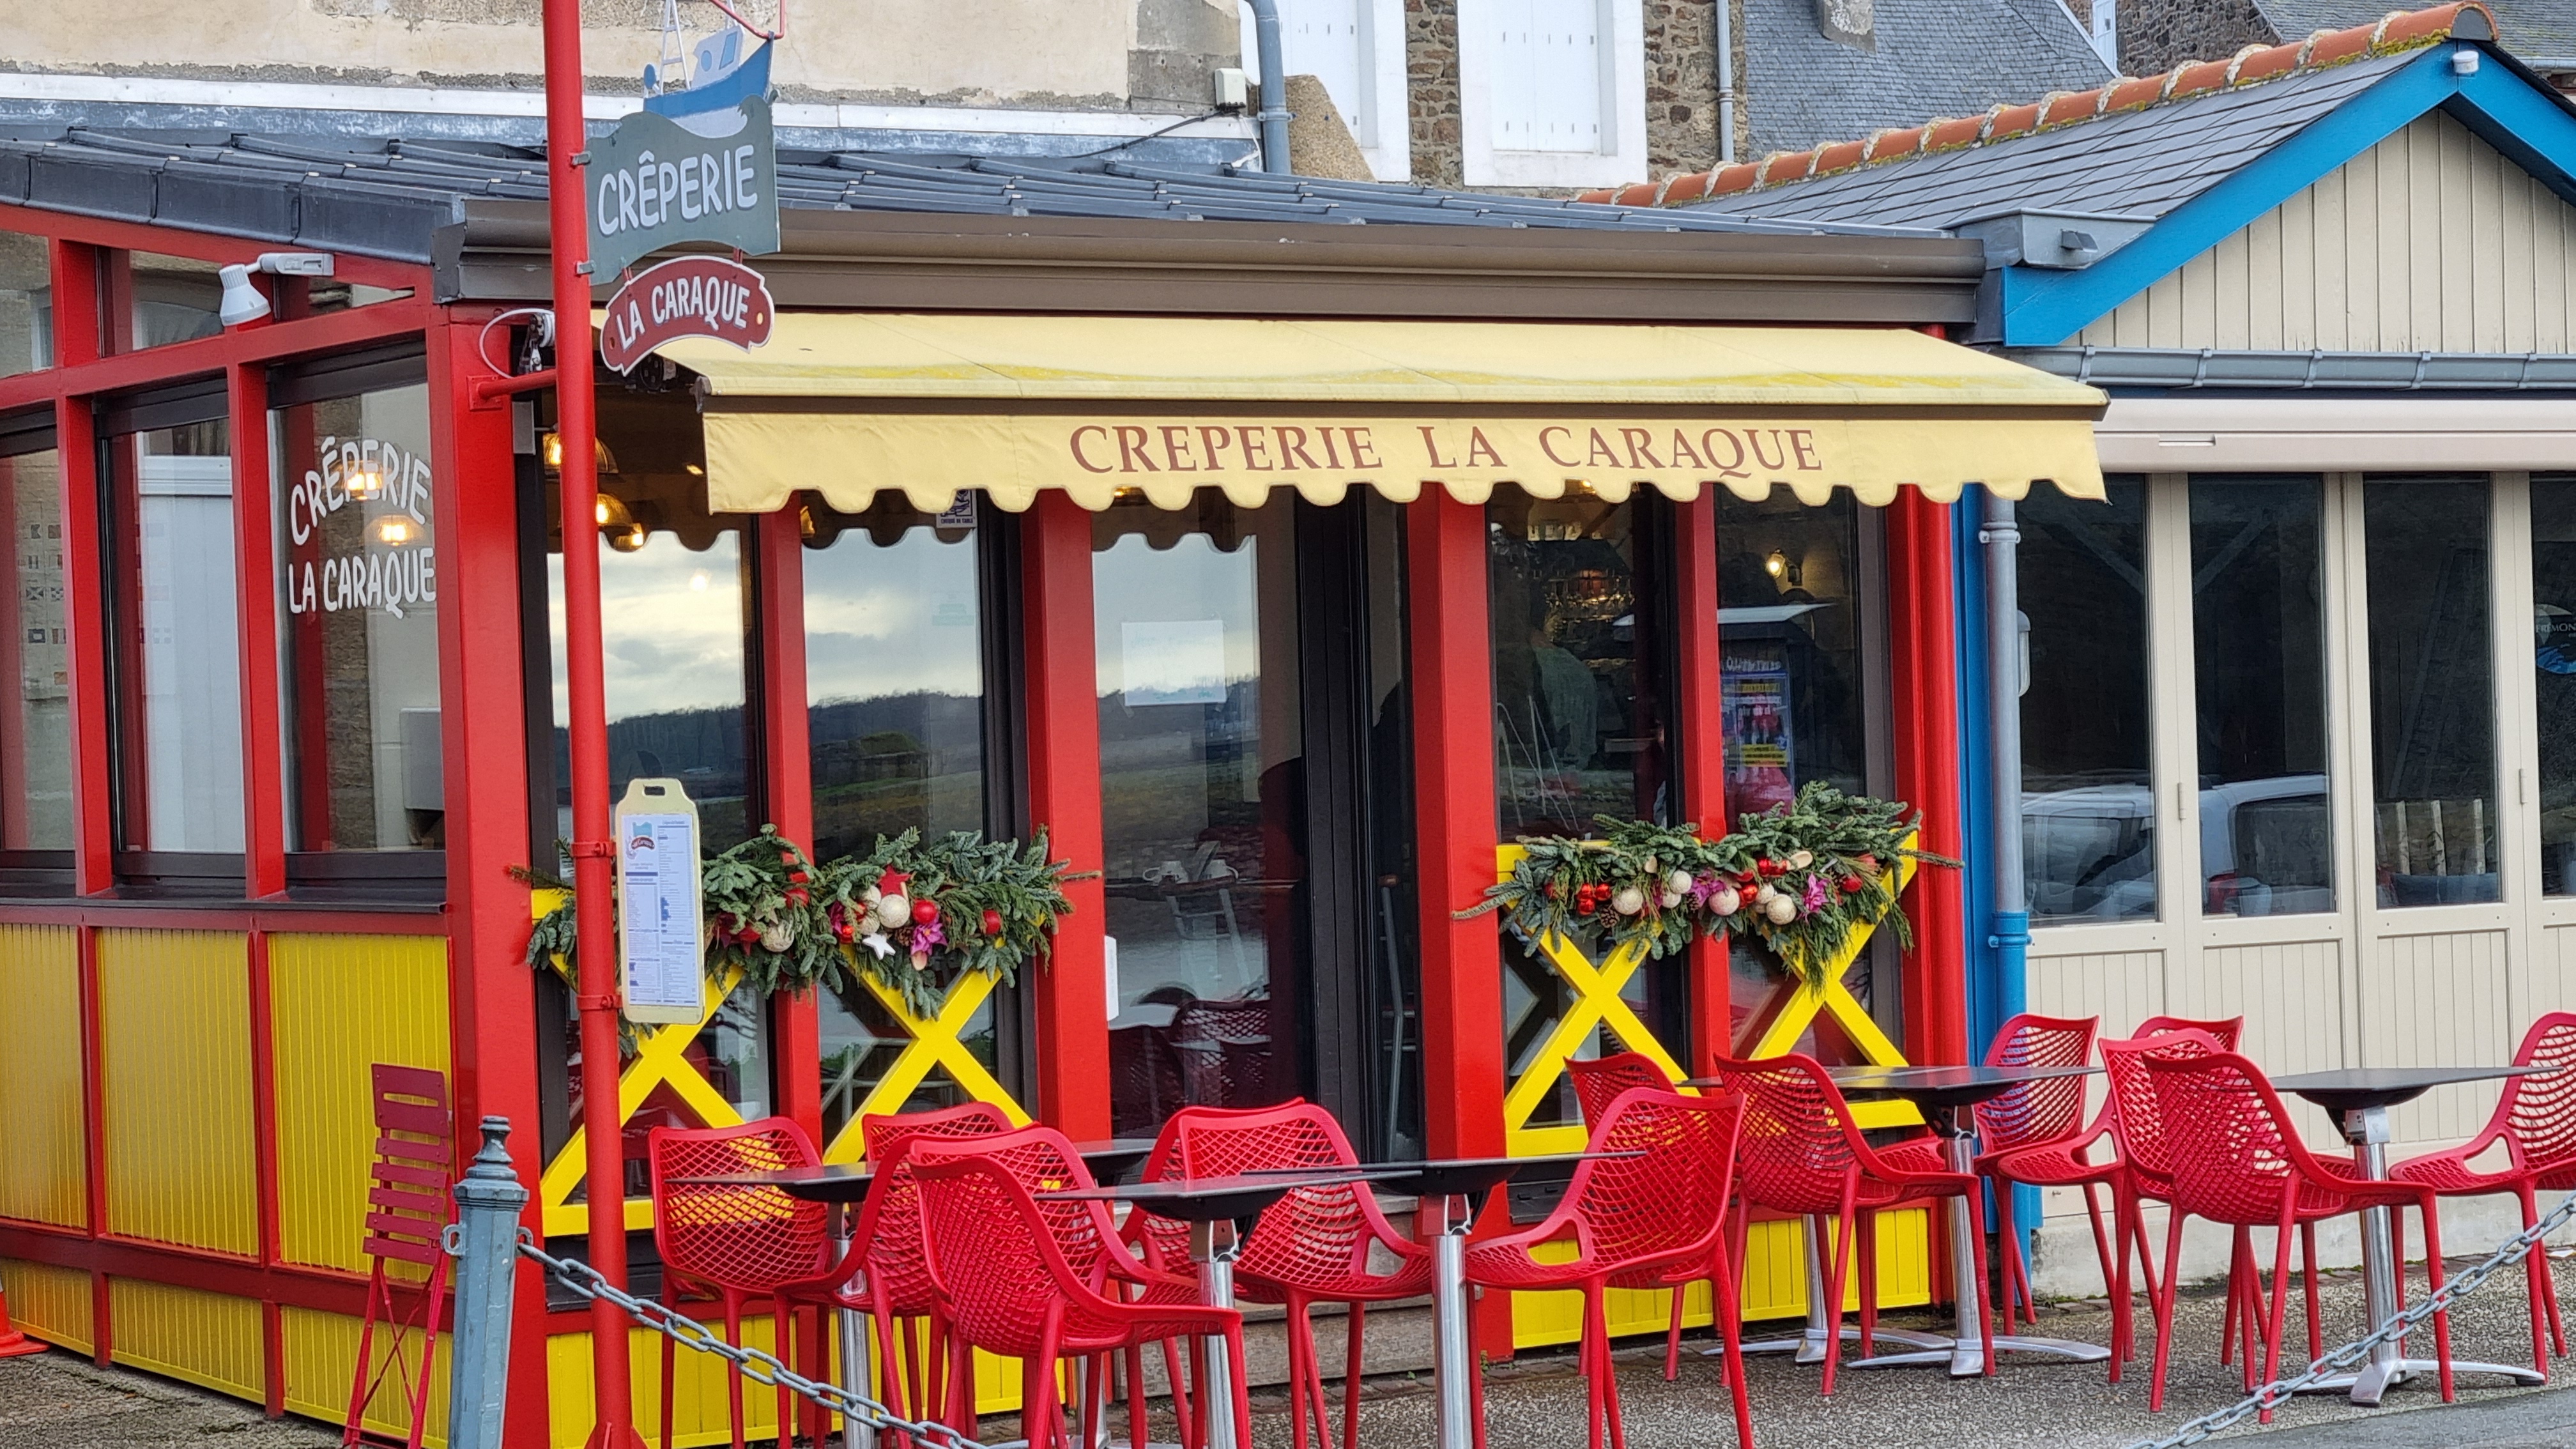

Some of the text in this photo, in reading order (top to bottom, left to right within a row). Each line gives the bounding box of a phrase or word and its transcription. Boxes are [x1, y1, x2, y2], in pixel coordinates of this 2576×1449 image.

[598, 145, 757, 235] CRÊPERIE
[617, 275, 750, 351] LA CARAQUE
[1071, 425, 1823, 479] CREPERIE LA CARAQUE
[291, 436, 431, 546] CRÊPERIE
[289, 548, 436, 619] LA CARAQUE
